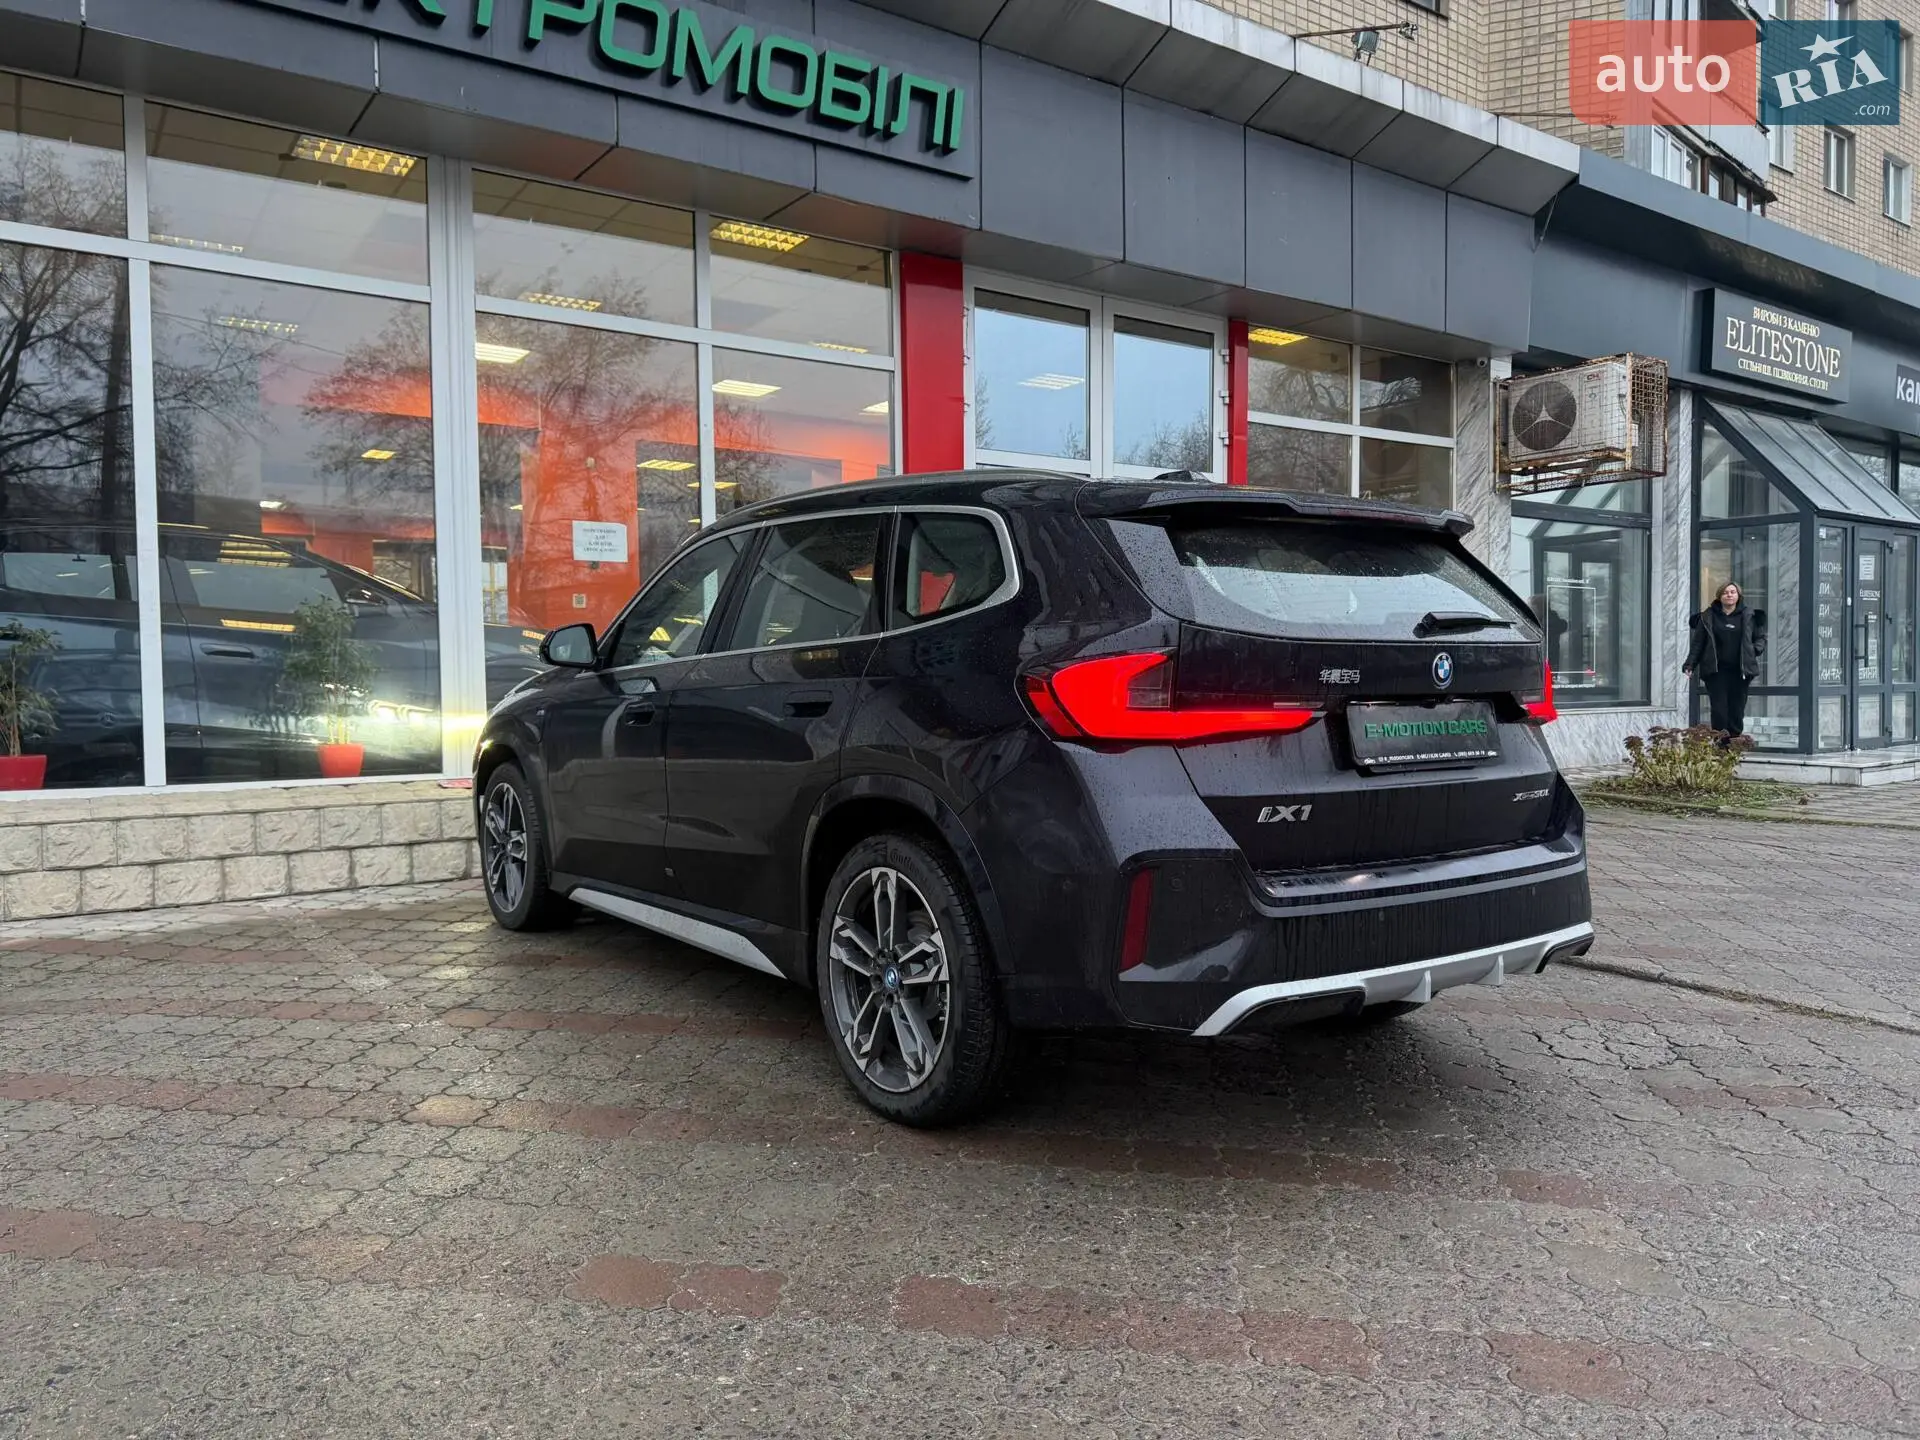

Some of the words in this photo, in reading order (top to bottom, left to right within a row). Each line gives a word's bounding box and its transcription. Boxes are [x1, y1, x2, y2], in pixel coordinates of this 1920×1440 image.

[418, 0, 964, 150] РОМОБІЛІ
[1725, 316, 1841, 378] ELITESTONE
[1365, 720, 1445, 739] E-MOTION
[1447, 719, 1488, 736] CARS
[1257, 803, 1313, 823] iX1
